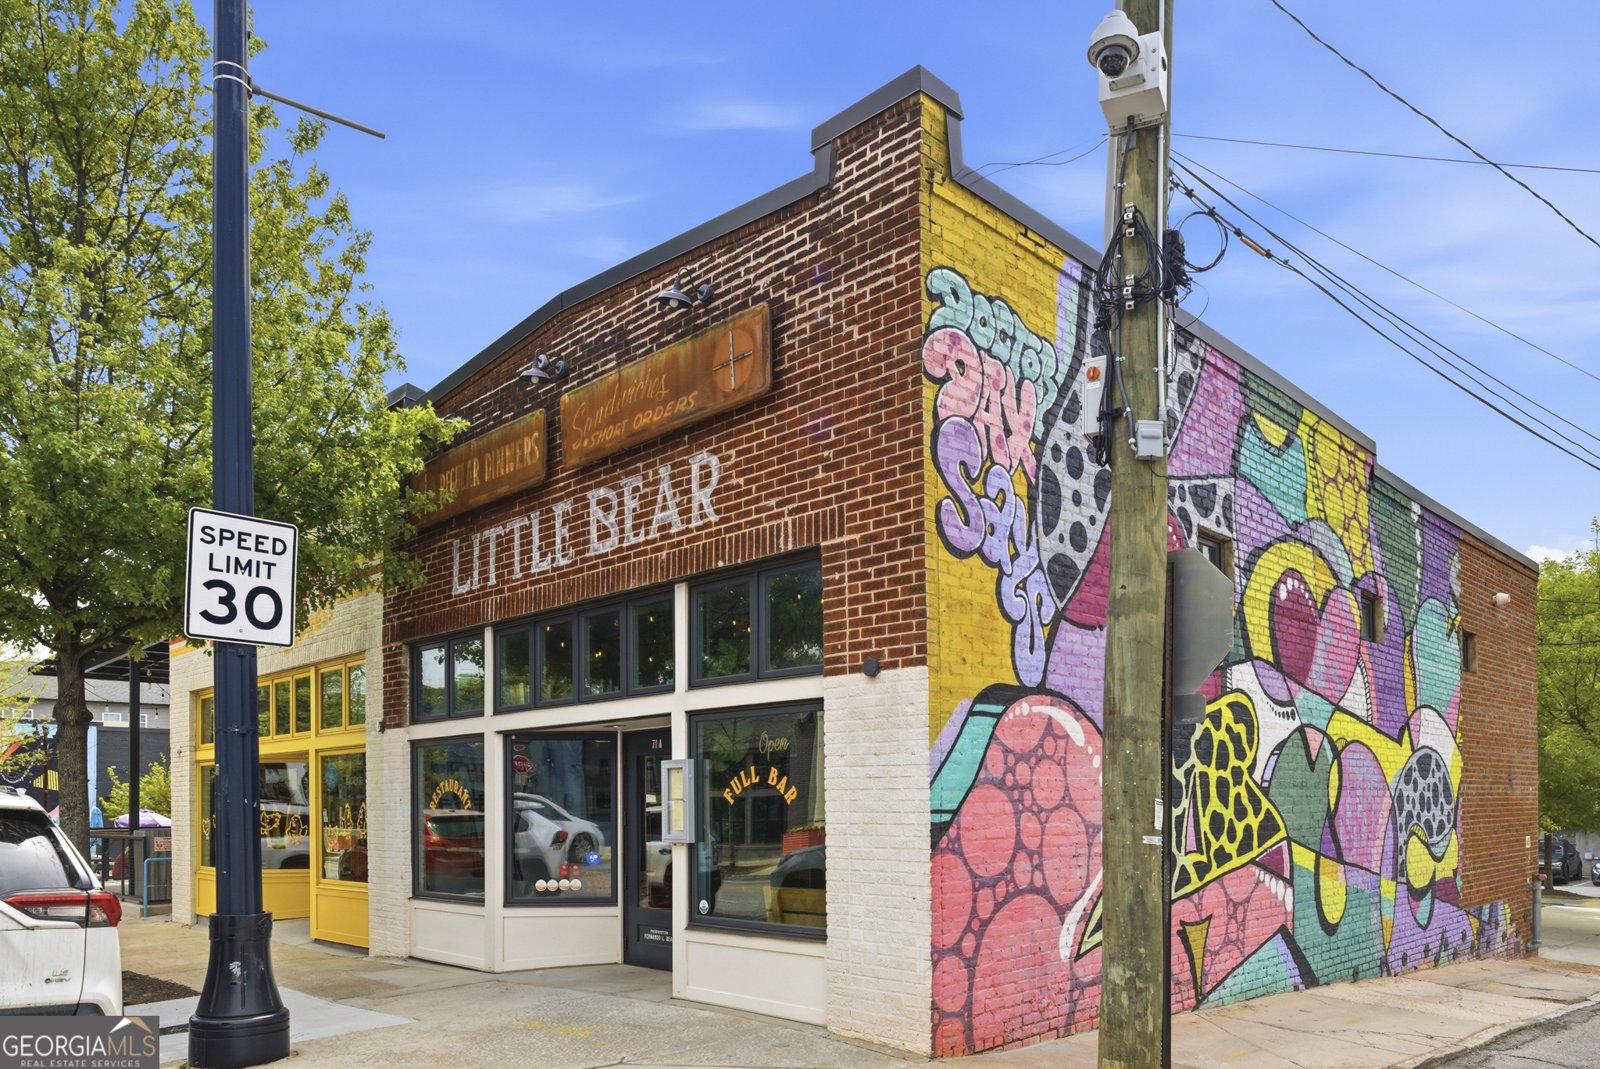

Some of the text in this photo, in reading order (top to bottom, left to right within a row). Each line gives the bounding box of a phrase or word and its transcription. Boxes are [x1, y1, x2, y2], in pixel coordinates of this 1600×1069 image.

[926, 266, 1059, 440] DOCTOR
[572, 367, 670, 450] Sandwiches
[588, 391, 698, 449] SHORT ORDERS
[485, 431, 540, 482] DINNERS
[199, 525, 288, 556] SPEED
[452, 450, 721, 596] LITTLE BEAR
[208, 552, 277, 580] LIMIT
[199, 578, 284, 631] 30
[759, 731, 789, 761] Open
[429, 778, 472, 812] RESTAURANT
[723, 765, 760, 806] FULL
[768, 766, 798, 805] BAR
